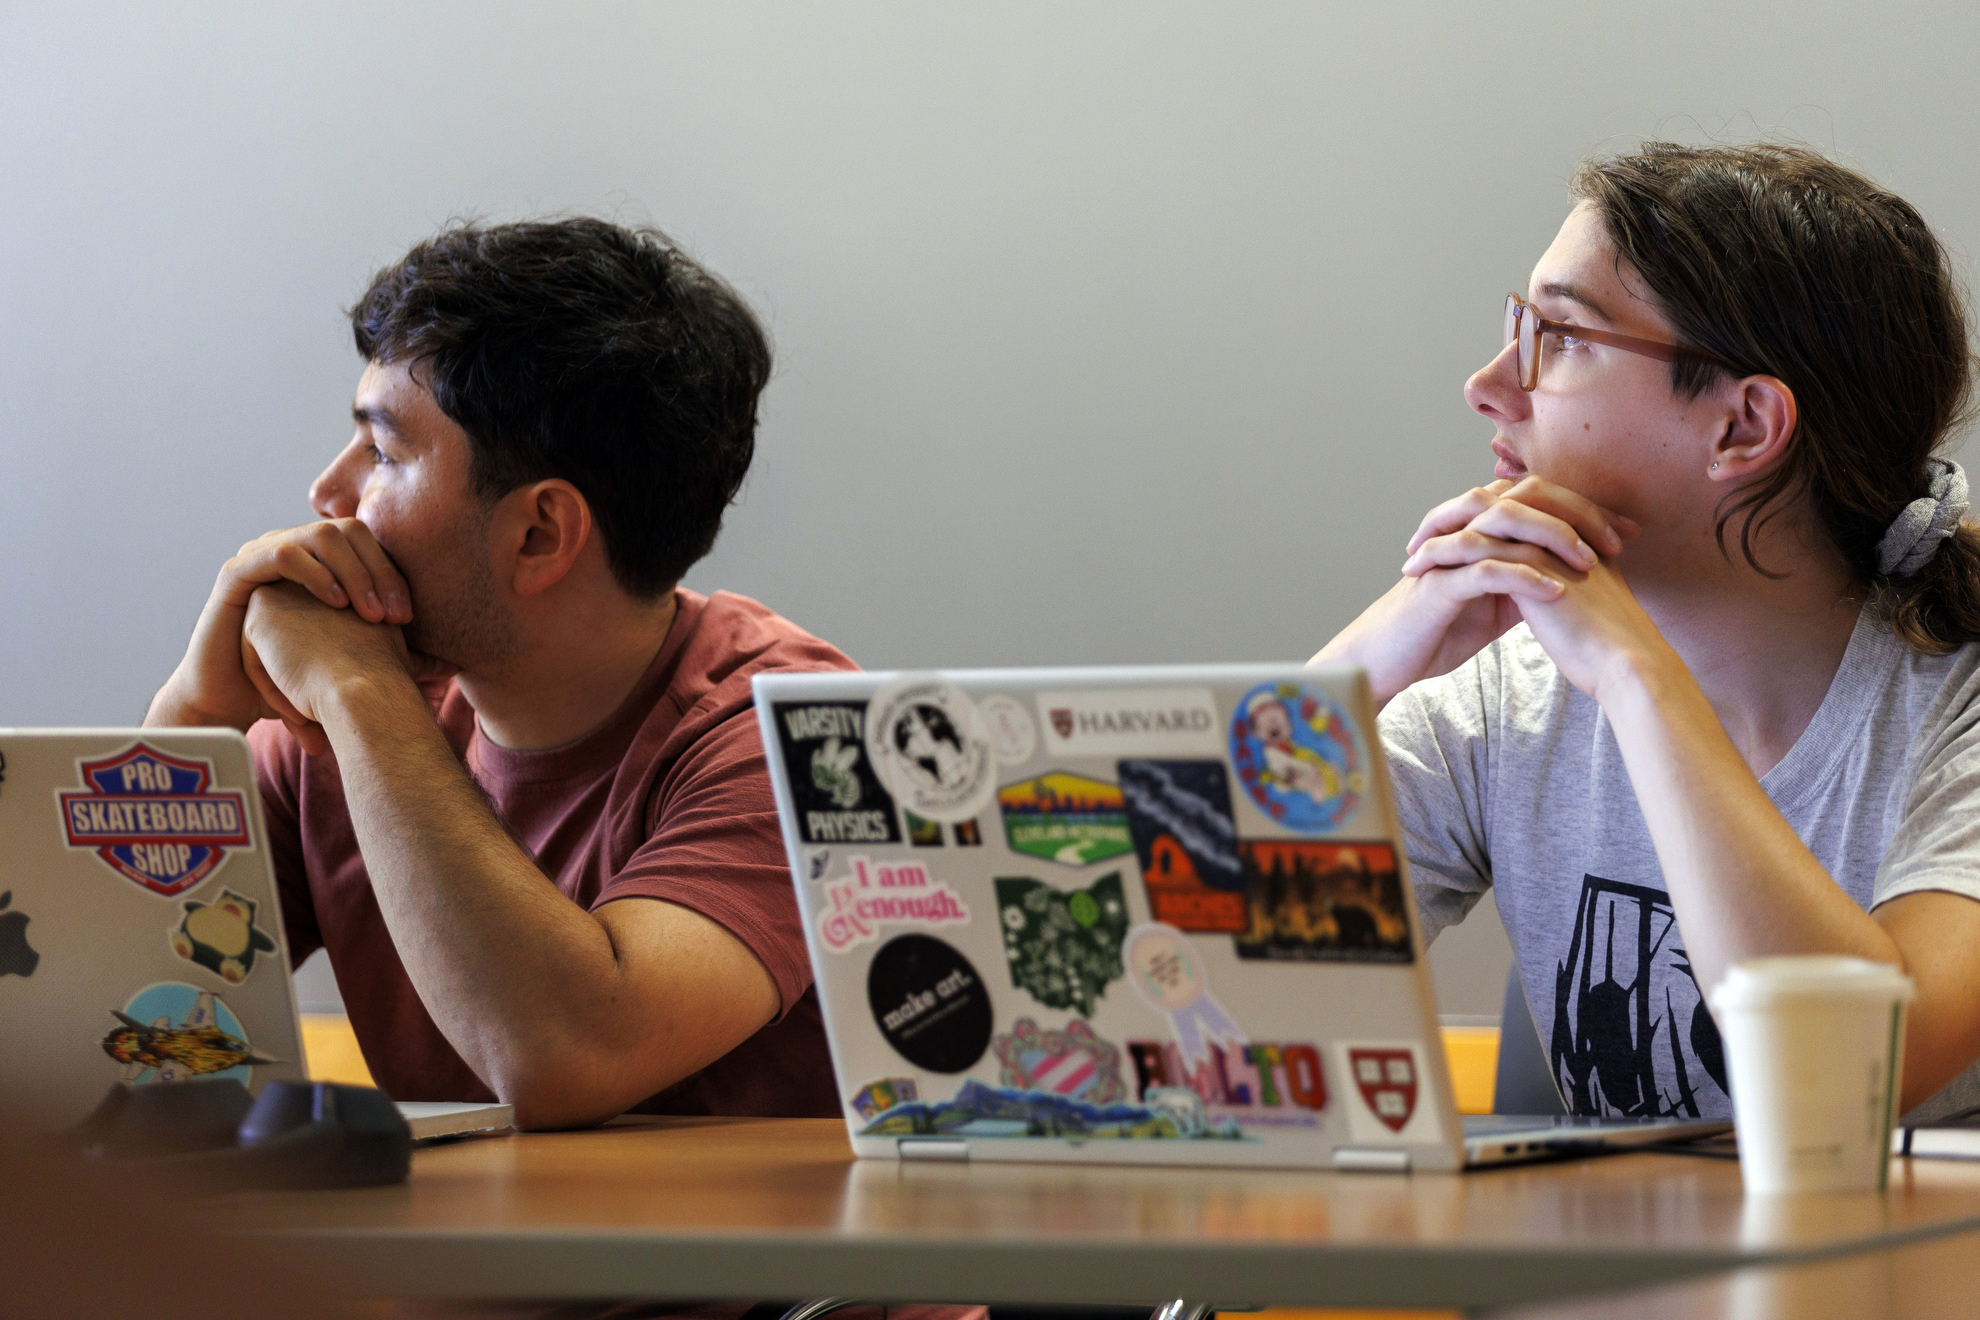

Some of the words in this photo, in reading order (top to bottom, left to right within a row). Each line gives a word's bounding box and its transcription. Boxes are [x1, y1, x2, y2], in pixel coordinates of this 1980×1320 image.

[784, 705, 863, 742] VARSITY
[1078, 708, 1212, 735] HARVARD
[121, 761, 172, 791] PRO
[72, 802, 237, 832] SKATEBOARD
[806, 810, 891, 841] PHYSICS
[131, 843, 191, 877] SHOP
[854, 859, 870, 888] I
[877, 866, 927, 888] am
[883, 992, 937, 1031] make
[935, 968, 973, 998] art.
